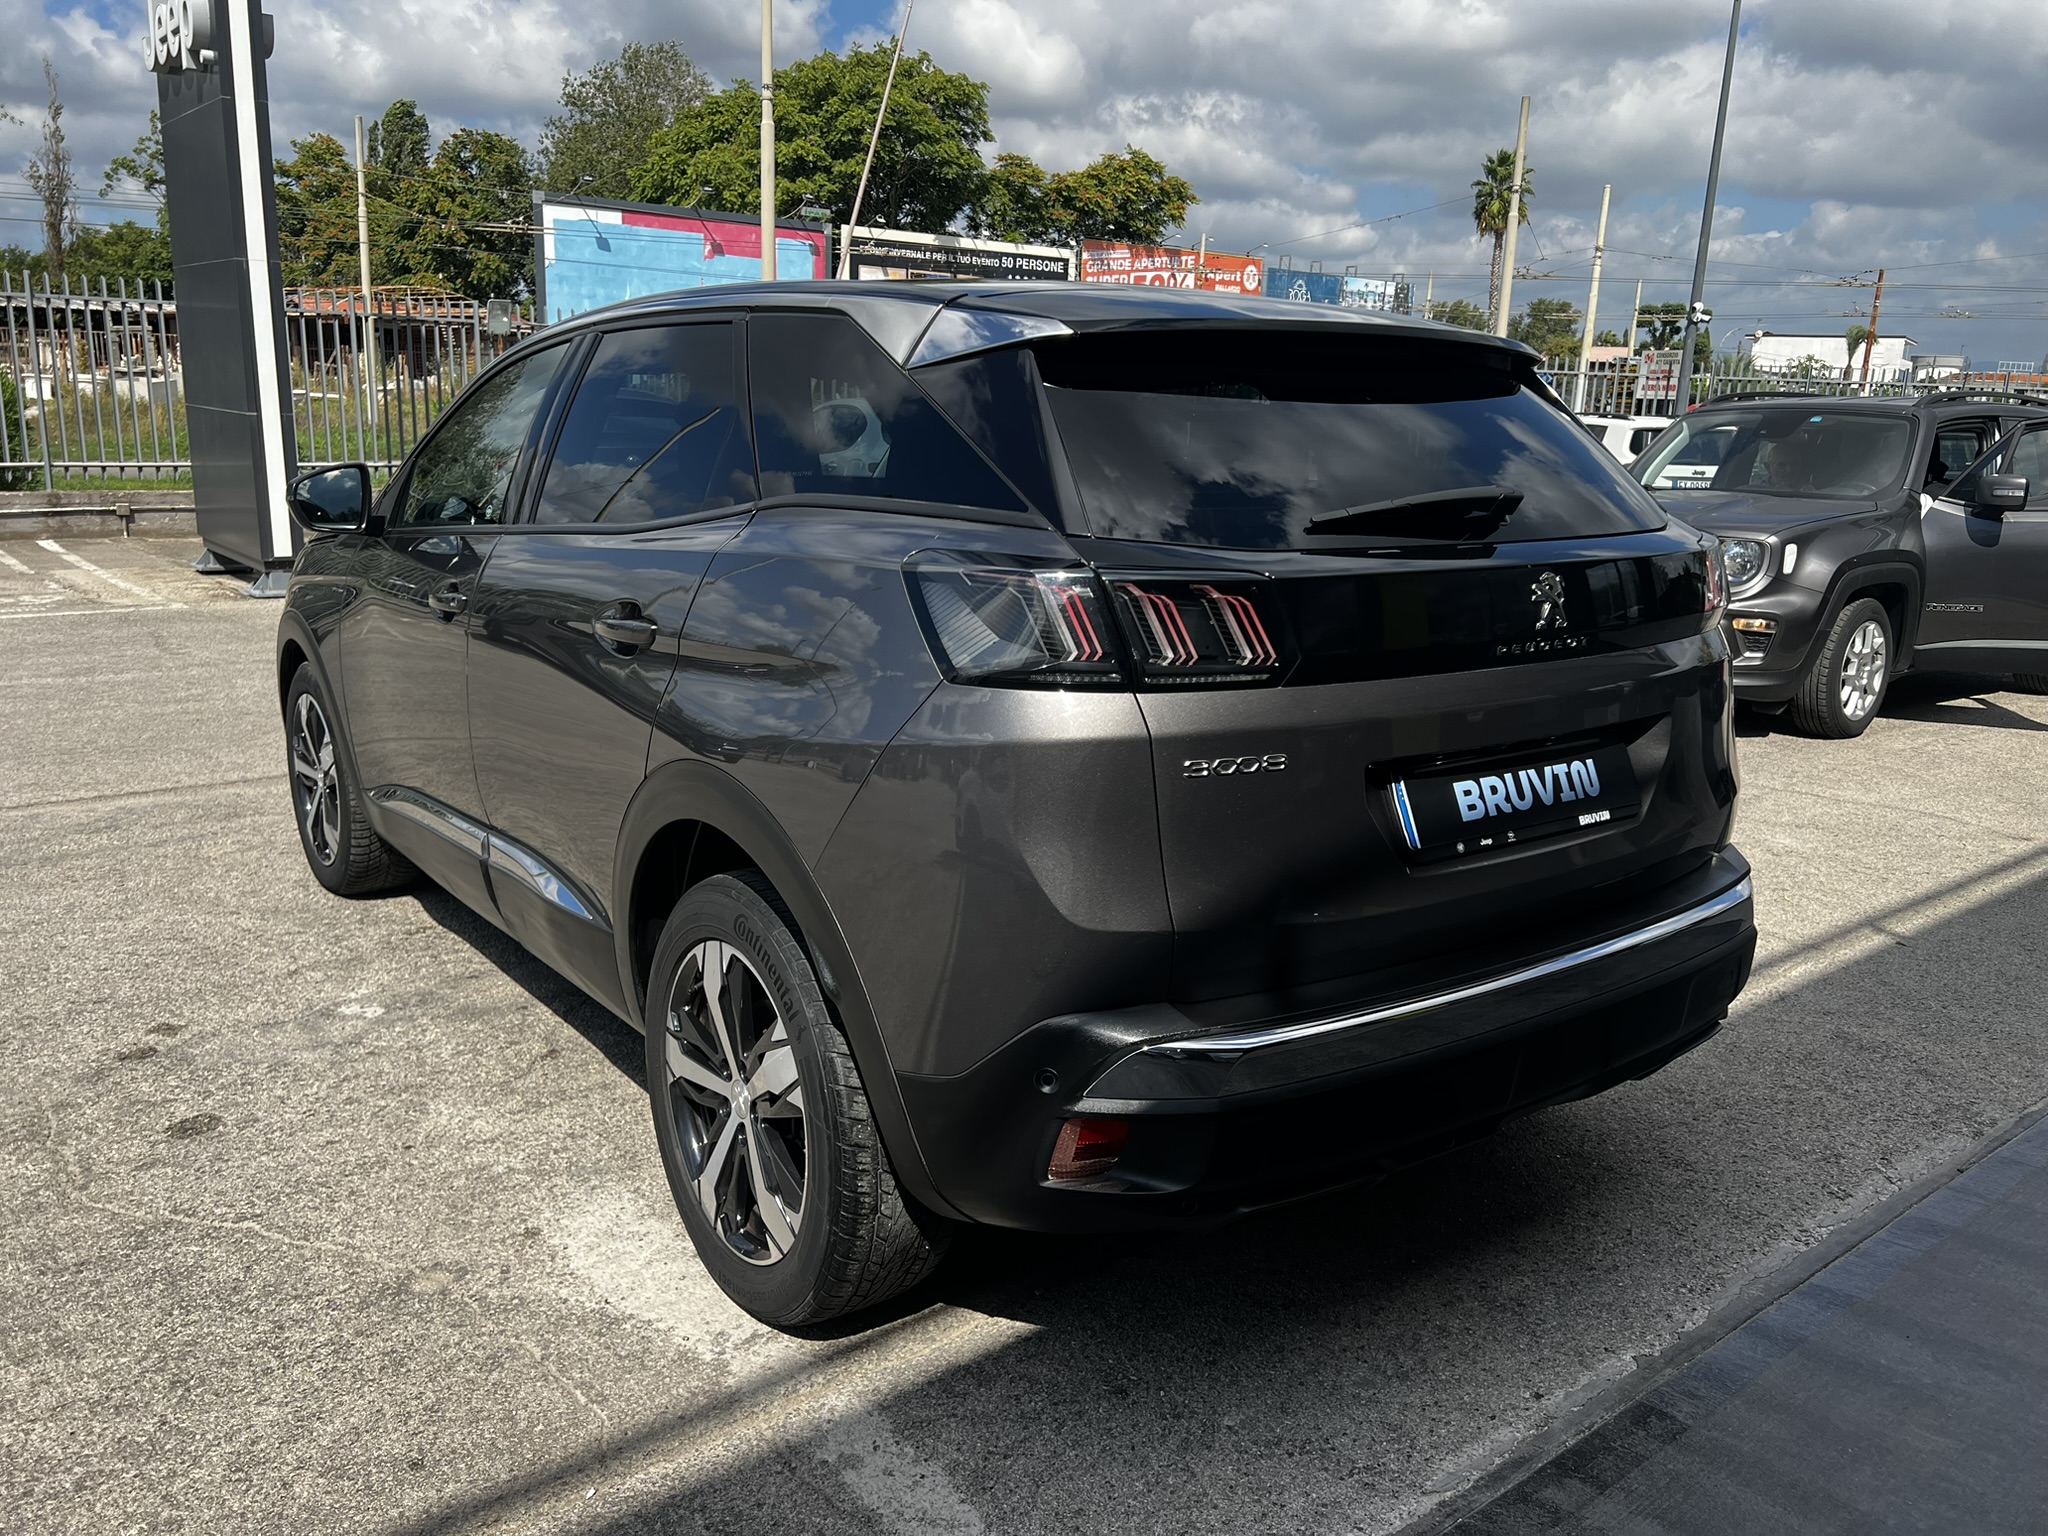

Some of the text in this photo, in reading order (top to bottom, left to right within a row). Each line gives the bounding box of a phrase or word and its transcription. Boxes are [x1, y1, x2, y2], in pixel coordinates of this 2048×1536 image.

[142, 0, 197, 71] Jeep
[956, 254, 971, 264] TUO
[972, 257, 999, 267] EVENTO
[1001, 257, 1013, 268] 50
[1016, 257, 1065, 273] PERSONE
[1086, 258, 1132, 272] GRANDE
[1691, 469, 1706, 477] Jeep
[1496, 635, 1589, 656] PEUGEOT
[1183, 753, 1288, 779] 3008
[1452, 758, 1601, 823] BRUVIN
[1578, 809, 1611, 826] BRUVIN
[733, 913, 800, 1023] Continental
